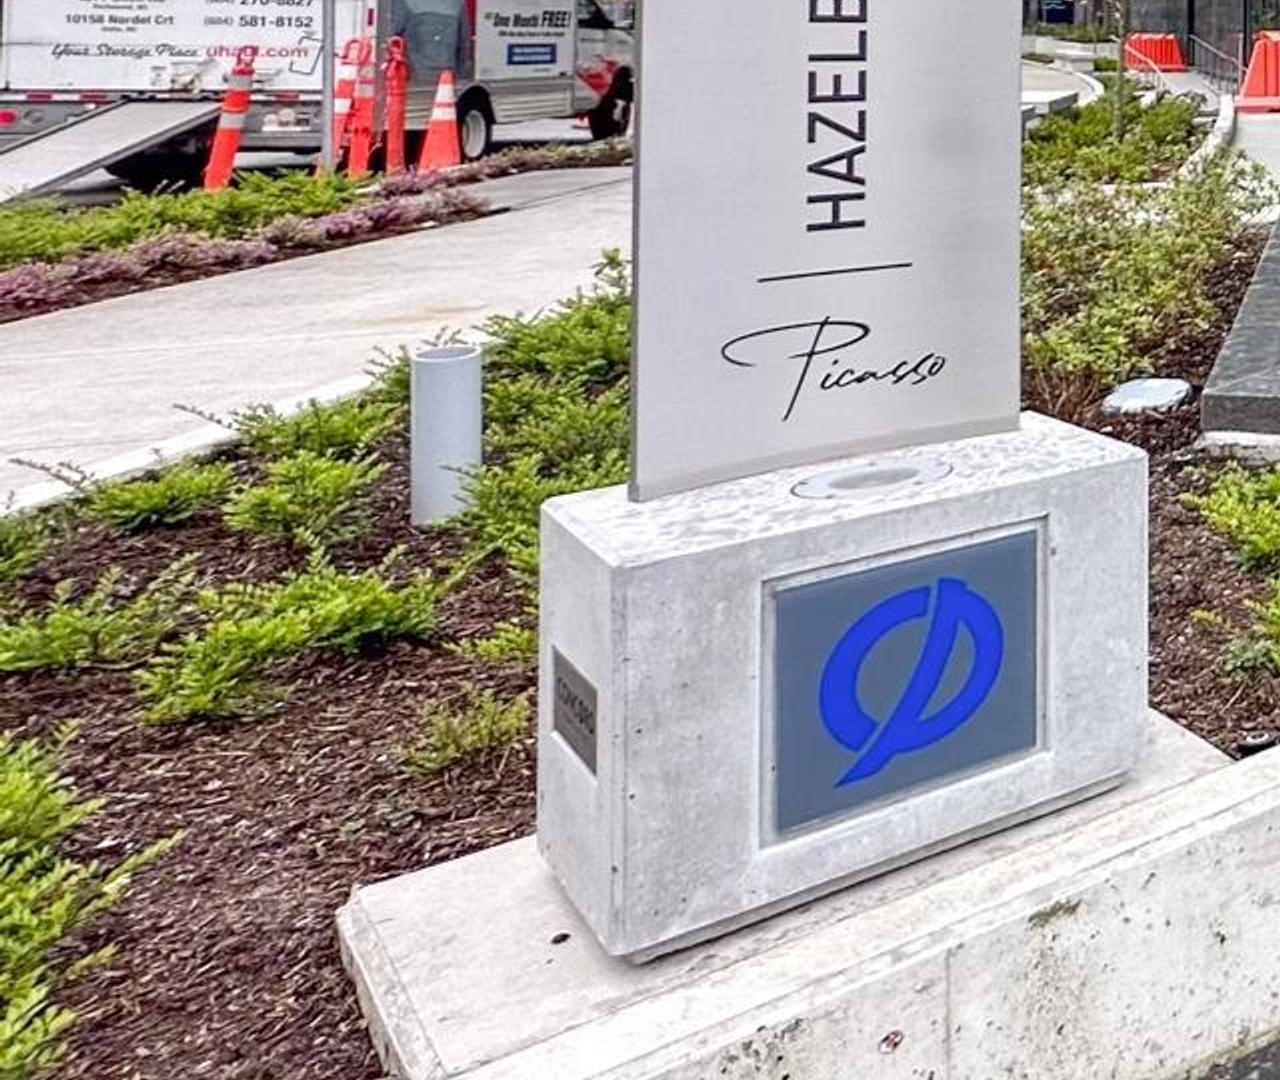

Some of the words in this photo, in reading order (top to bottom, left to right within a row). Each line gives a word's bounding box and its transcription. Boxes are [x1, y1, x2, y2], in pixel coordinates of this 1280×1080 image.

[238, 15, 314, 28] 581-8152
[51, 43, 90, 60] Your
[95, 43, 153, 59] Storage
[721, 316, 946, 422] Picasso
